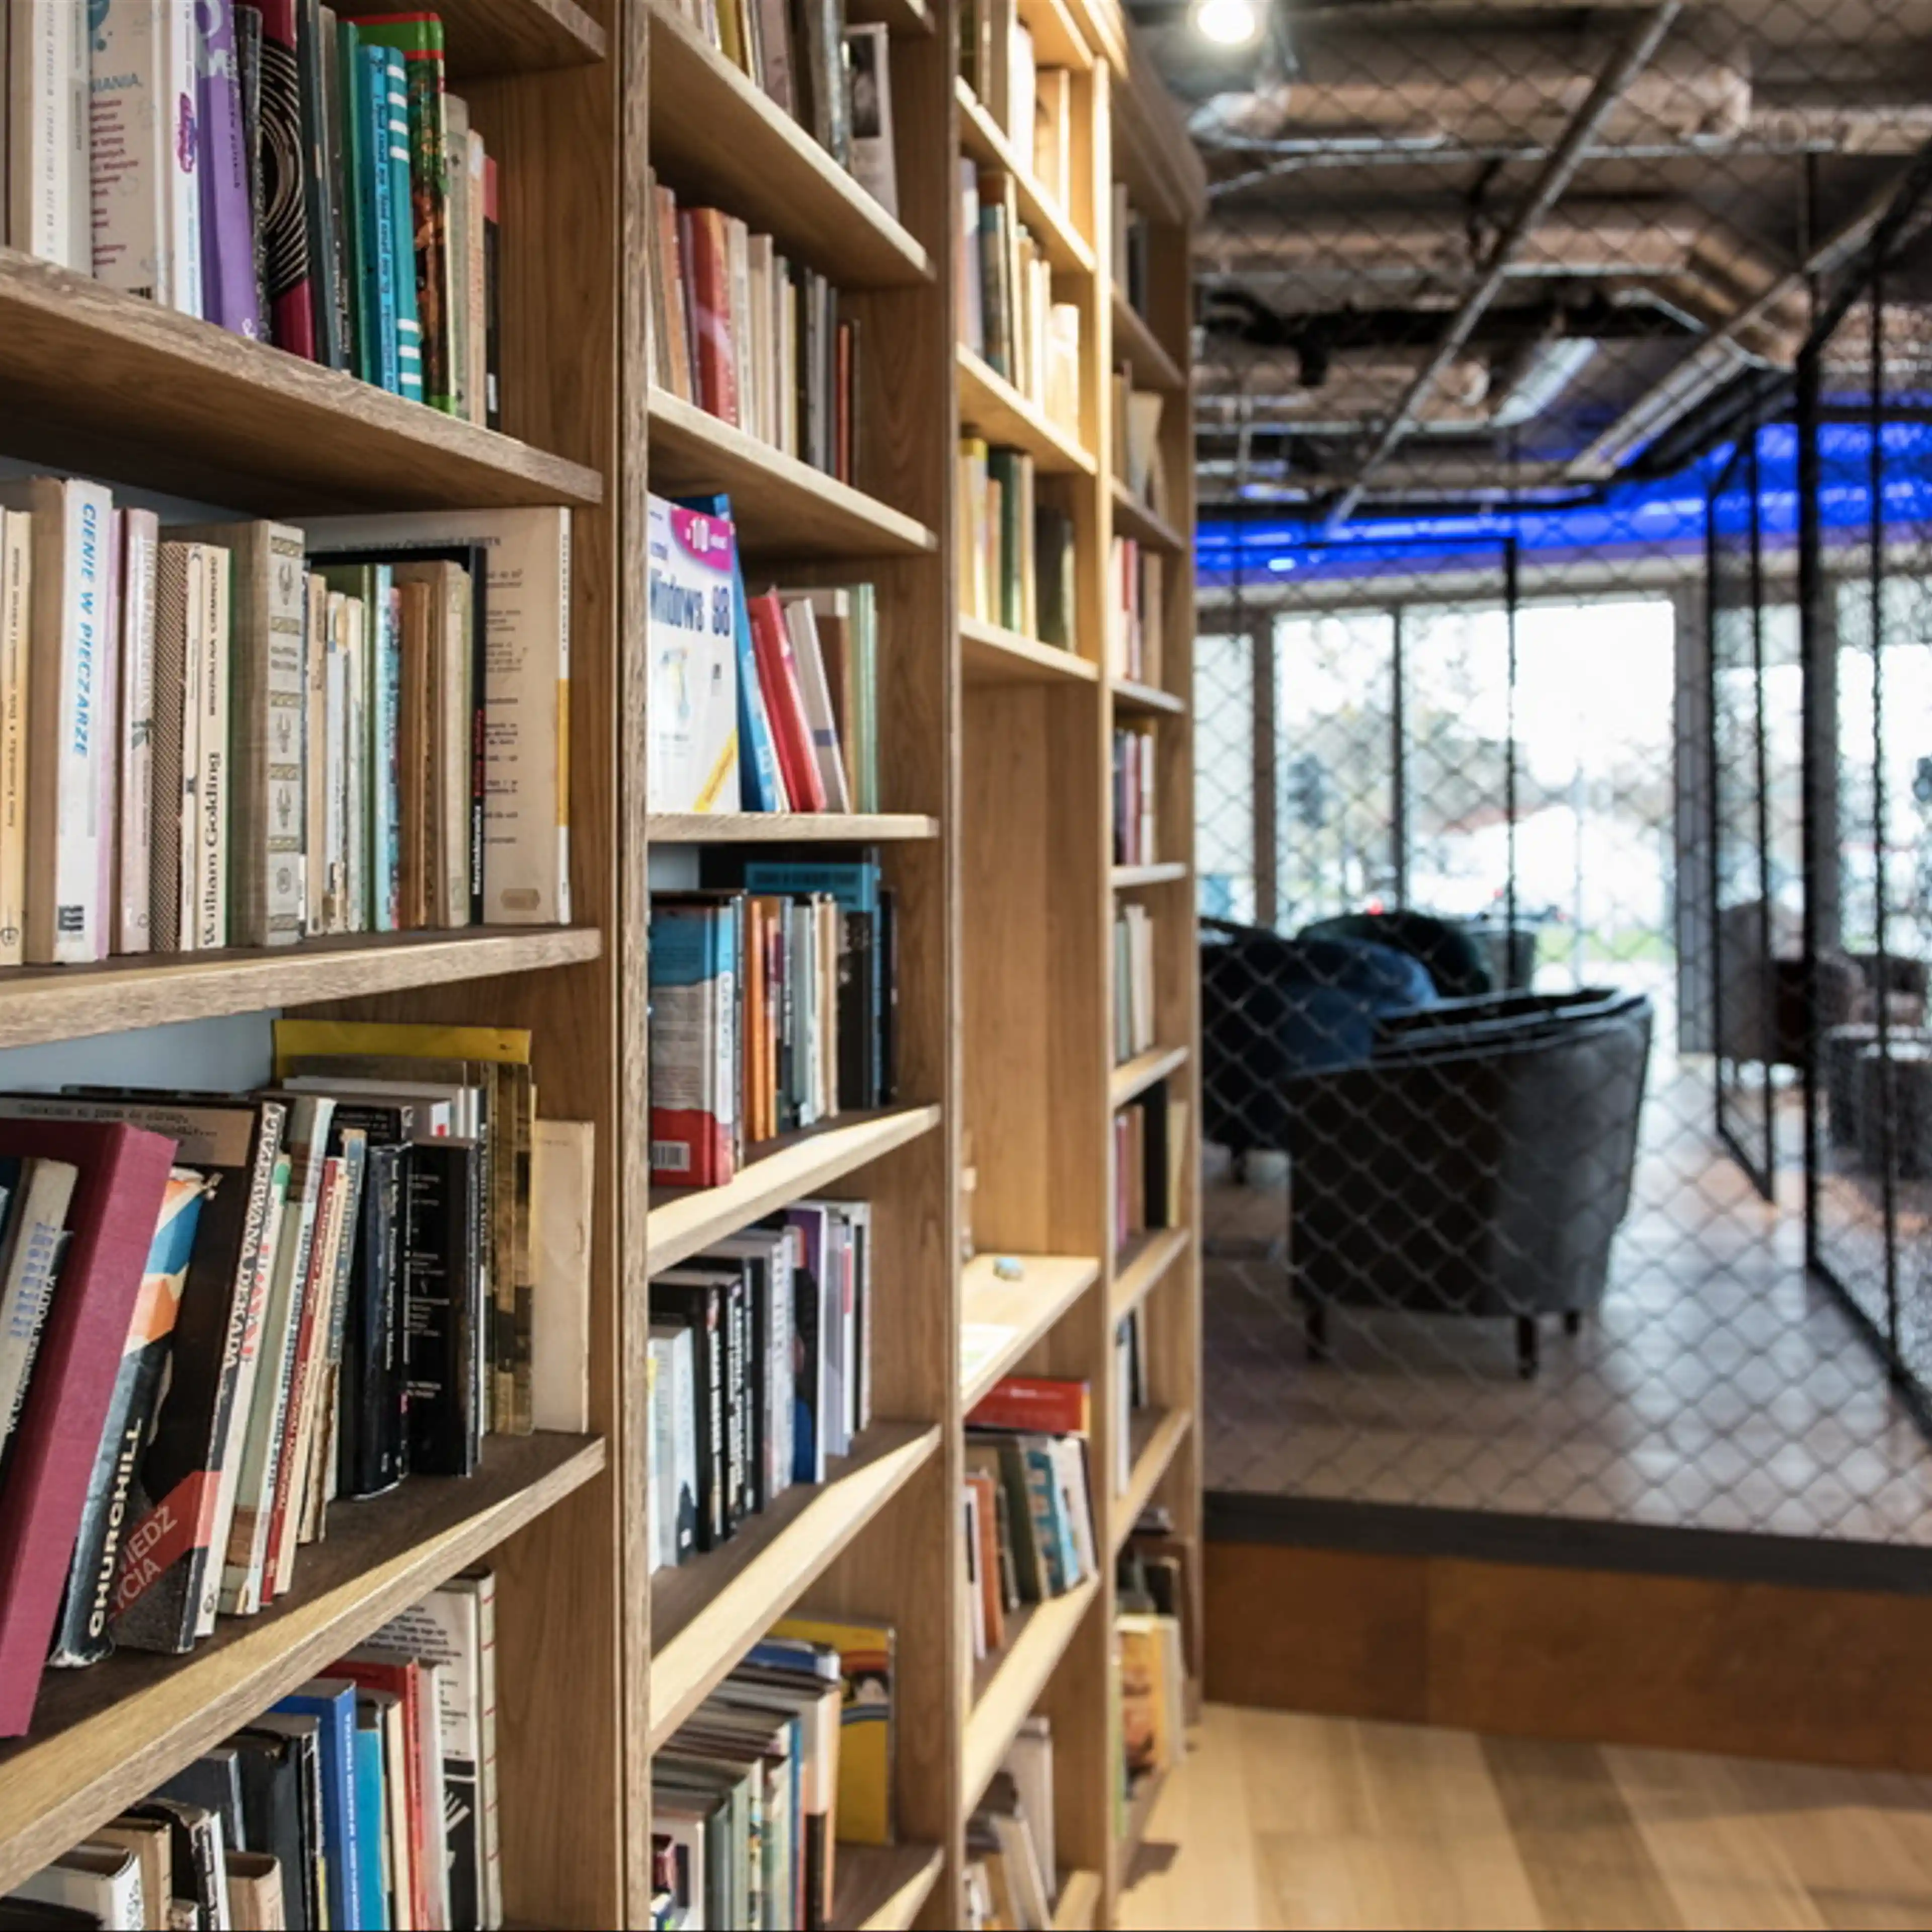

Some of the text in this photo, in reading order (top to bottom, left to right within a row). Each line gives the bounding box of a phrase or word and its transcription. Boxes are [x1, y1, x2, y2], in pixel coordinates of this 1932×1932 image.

[74, 503, 97, 757] CIENIE W PIECZARZE
[203, 752, 221, 847] Golding
[203, 852, 219, 946] William
[223, 1273, 253, 1368] DEKADA
[88, 1416, 143, 1639] CHURCHILL
